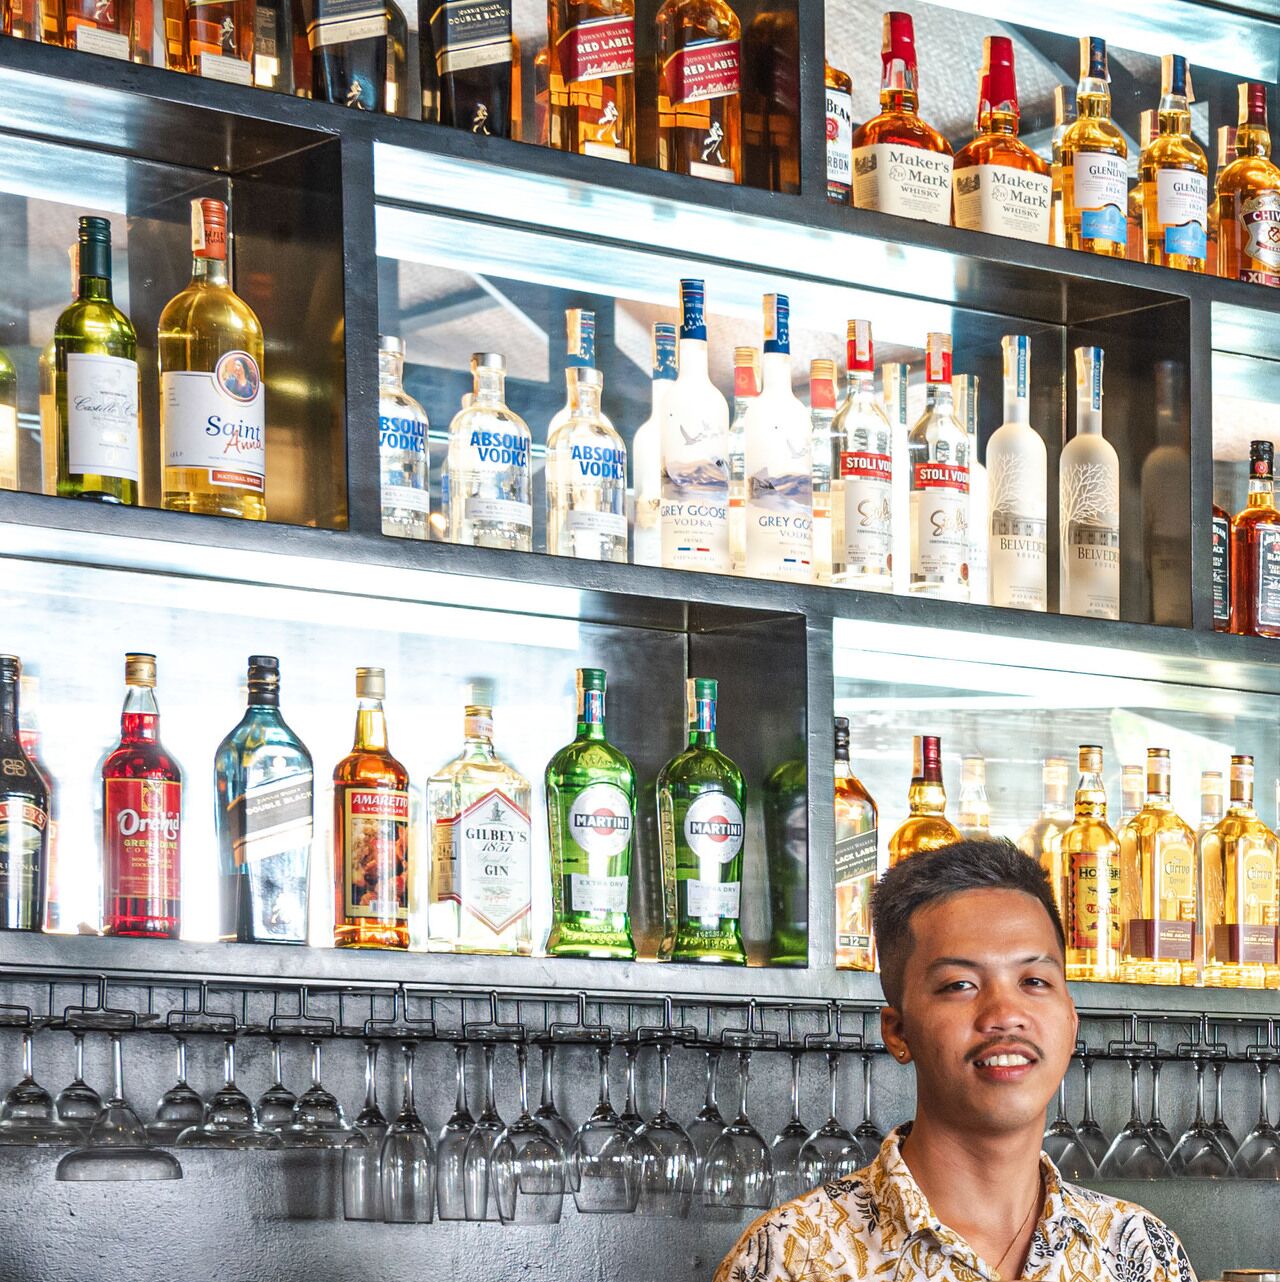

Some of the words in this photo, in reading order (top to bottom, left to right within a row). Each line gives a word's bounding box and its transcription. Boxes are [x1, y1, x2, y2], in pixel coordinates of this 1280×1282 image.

[448, 13, 483, 25] DOUBLE
[484, 9, 511, 20] BLACK
[577, 43, 600, 54] RED
[602, 37, 634, 49] LABEL
[683, 65, 706, 76] RED
[707, 58, 739, 72] LABEL
[827, 157, 849, 171] RBON
[889, 151, 950, 174] Maker's
[1107, 160, 1119, 168] THE
[908, 169, 949, 189] Mark
[992, 171, 1049, 194] Maker's
[900, 185, 941, 199] WHISKY
[1010, 189, 1048, 208] Mark
[1002, 205, 1040, 219] WHISKY
[1249, 272, 1267, 284] XII
[205, 414, 261, 441] Saint
[379, 415, 429, 437] BSOLU
[224, 433, 263, 455] Anna
[478, 447, 527, 468] VODKA
[571, 445, 626, 466] ABSOLU
[846, 456, 877, 470] STOLI
[579, 461, 624, 480] VODKA
[920, 468, 949, 481] STOLI
[951, 469, 970, 484] VOD
[661, 505, 682, 518] GREY
[687, 505, 727, 520] GOOSE
[673, 519, 713, 528] VODKA
[758, 516, 790, 529] GREY
[1000, 536, 1047, 553] BELVEDE
[1213, 546, 1225, 554] ACK
[1077, 547, 1120, 563] BELVEDE
[246, 800, 282, 815] DOUBLE
[283, 791, 312, 804] BLACK
[353, 794, 409, 807] AMARETTO
[117, 808, 180, 840] Orchid
[575, 814, 629, 830] MARTINI
[691, 822, 742, 837] MARTINI
[466, 828, 527, 843] GILBEY'S
[124, 839, 177, 849] GRENDINE
[481, 841, 513, 853] 1857
[835, 854, 855, 865] LACK
[855, 845, 877, 859] LABEL
[484, 864, 509, 876] GIN
[610, 880, 624, 888] DRY
[724, 885, 737, 893] DRY
[850, 936, 860, 946] 12
